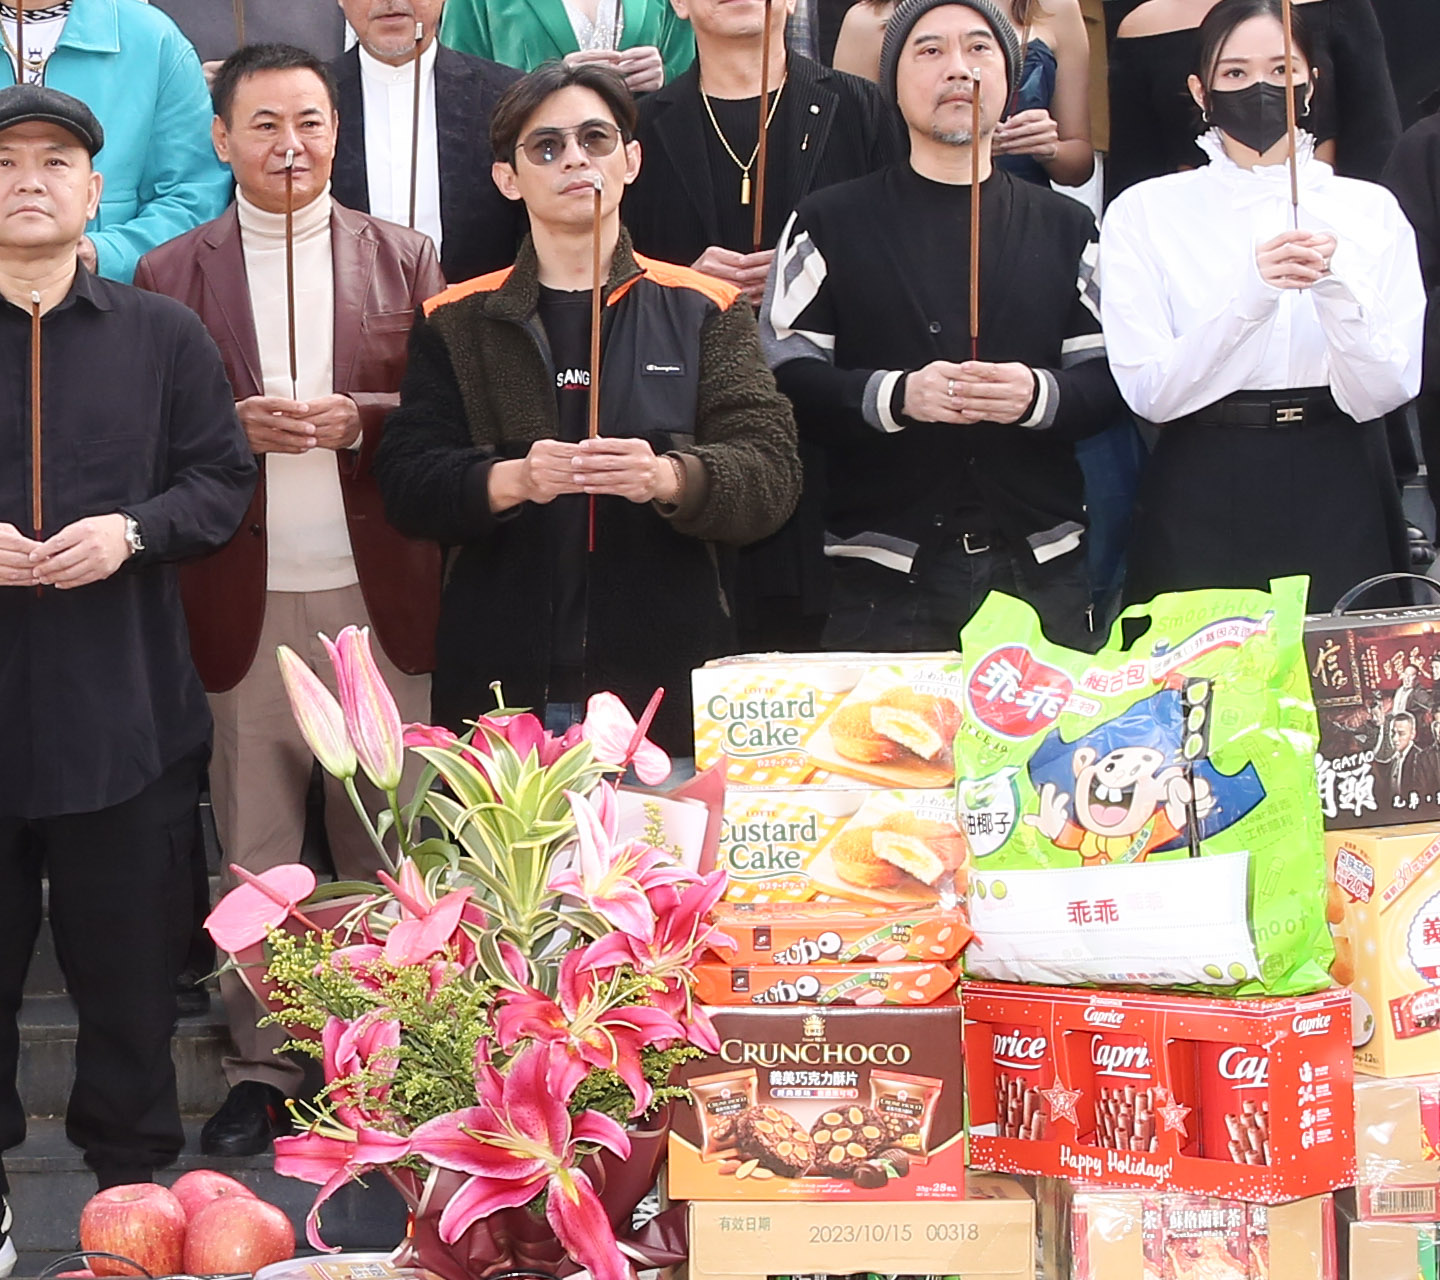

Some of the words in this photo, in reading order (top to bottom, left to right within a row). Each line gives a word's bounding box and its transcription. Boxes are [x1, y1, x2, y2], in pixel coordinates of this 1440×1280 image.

[977, 657, 1062, 721] 乖乖
[707, 691, 815, 721] Custard
[726, 722, 799, 747] Cake
[1067, 899, 1120, 927] 乖乖
[1084, 1007, 1125, 1028] Caprice
[721, 1039, 912, 1067] CRUNCHOCO
[769, 1069, 858, 1087] 義美巧克力酥片
[1059, 1144, 1103, 1176] Happy
[1106, 1148, 1174, 1184] Holidays!
[719, 1216, 771, 1232] 有效日期
[809, 1223, 913, 1245] 2023/10/15
[926, 1222, 979, 1242] 00318
